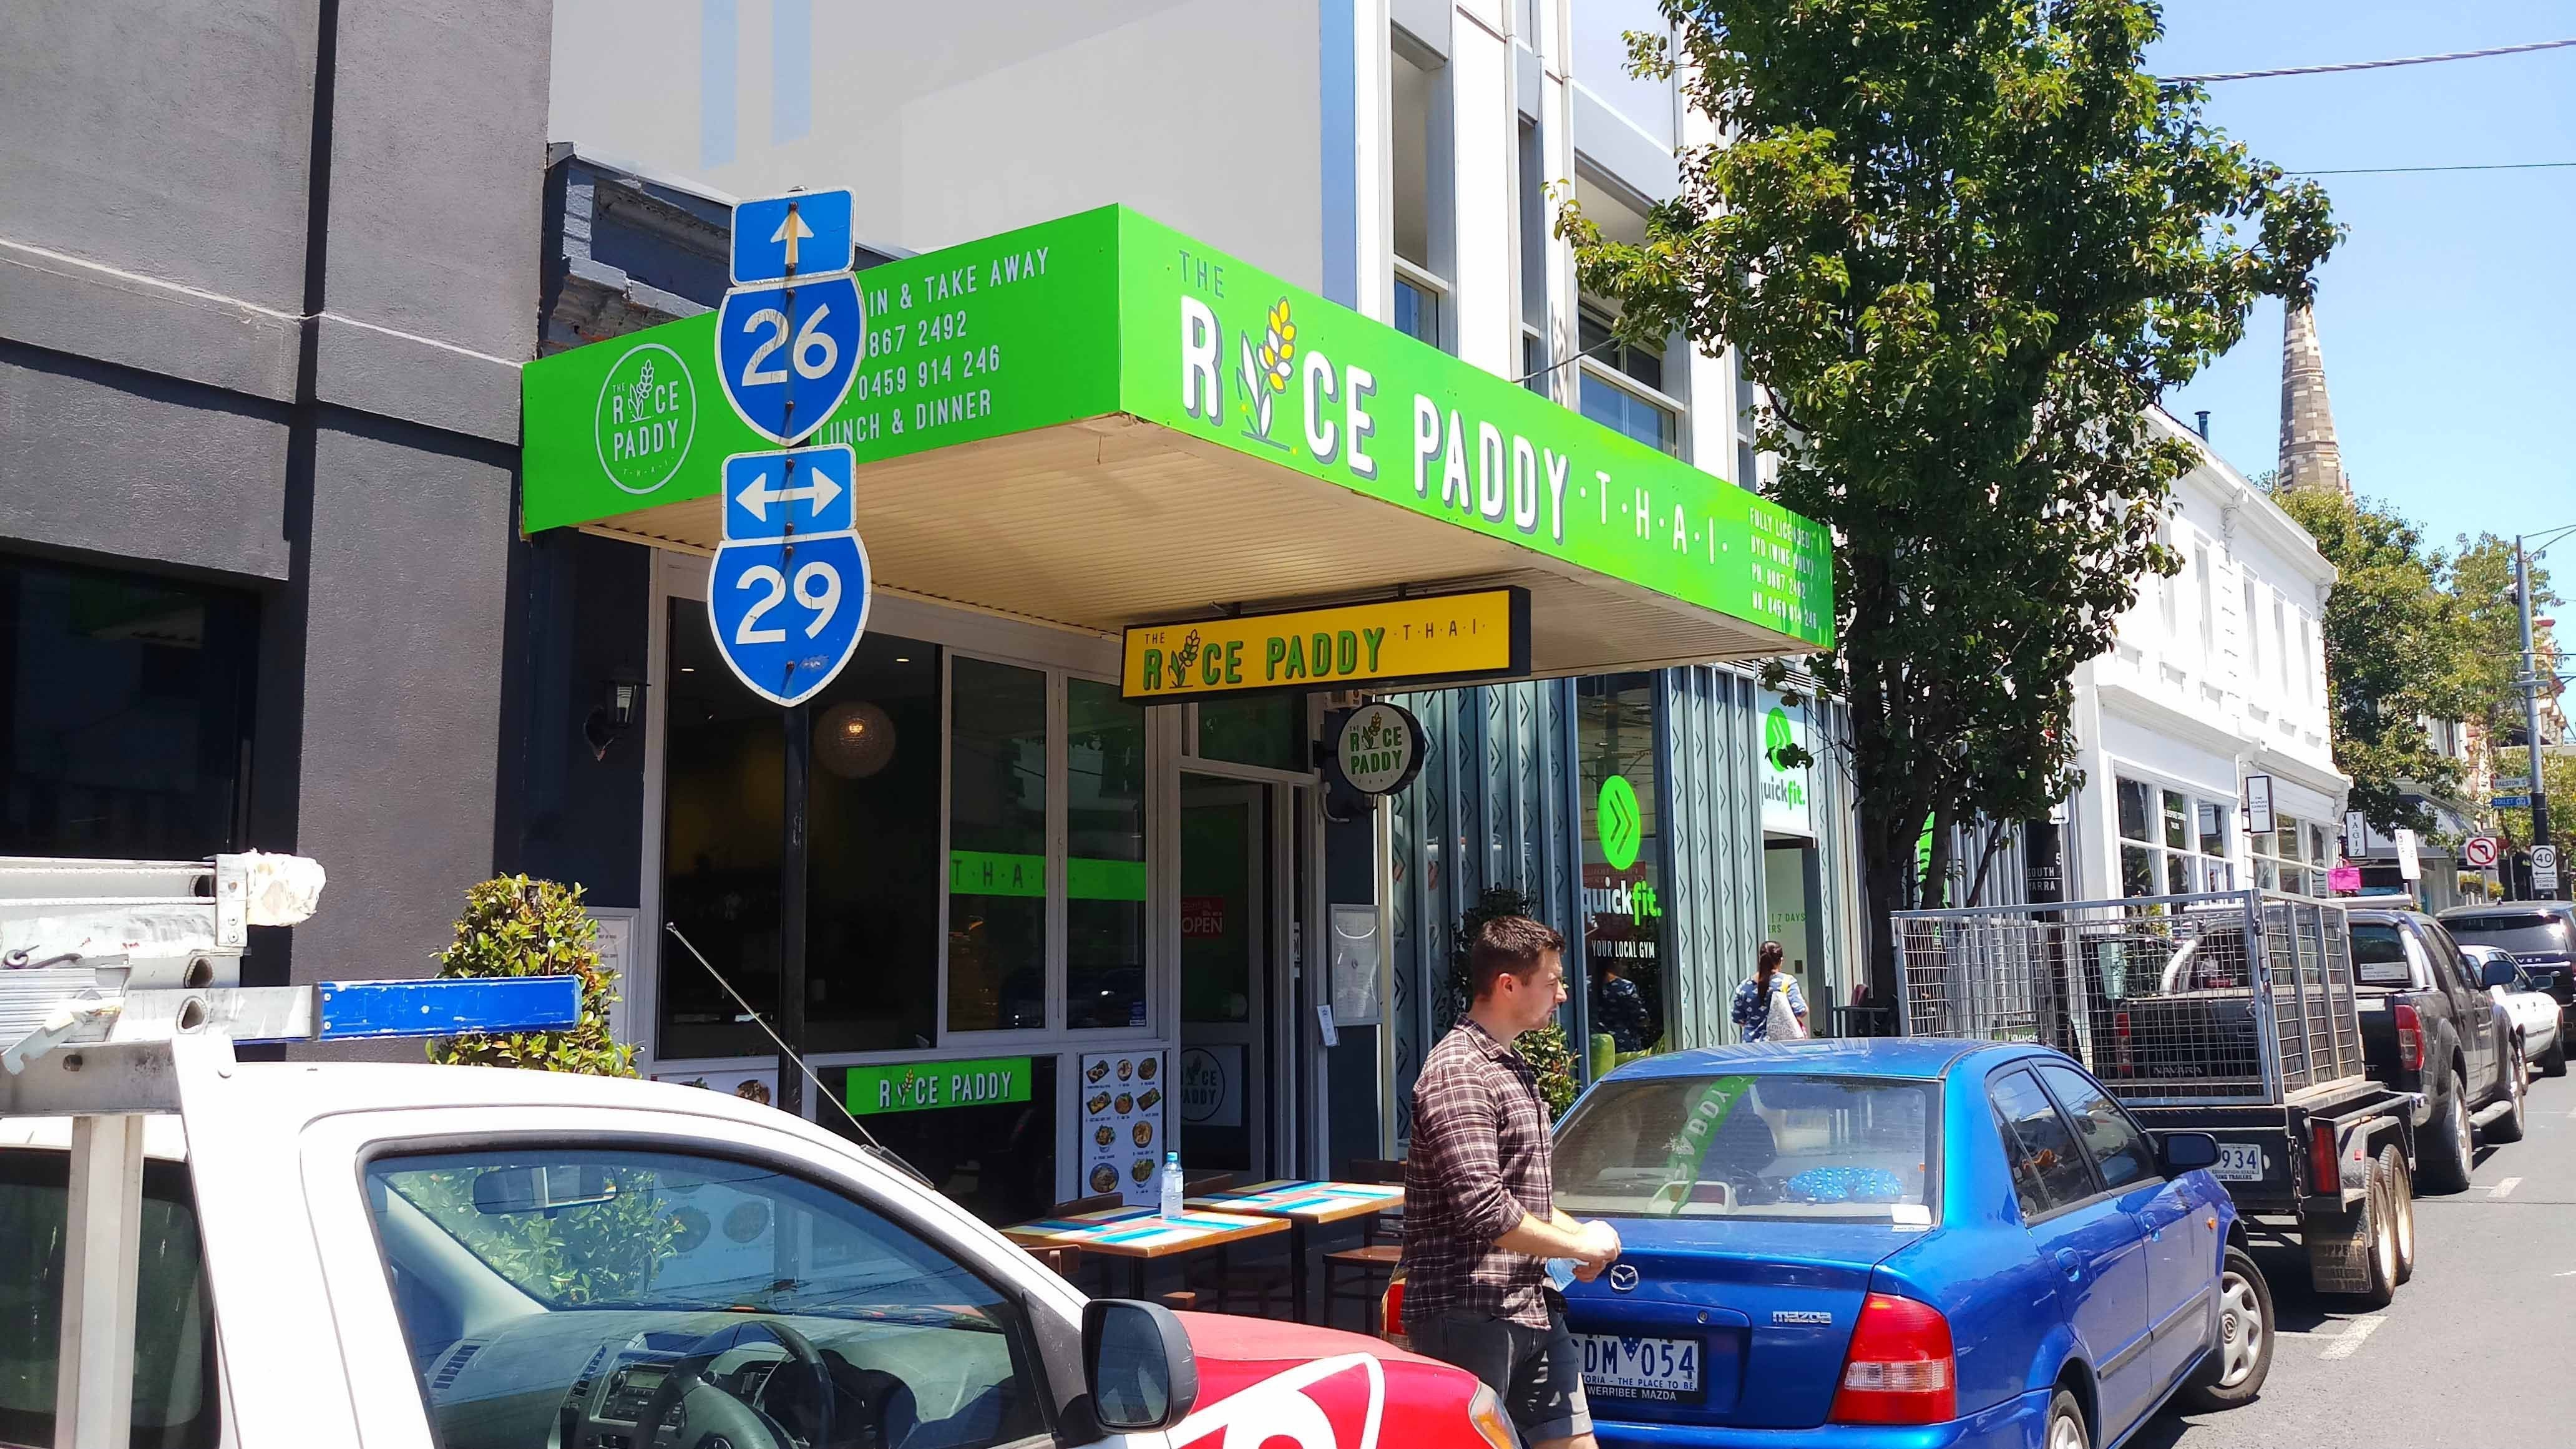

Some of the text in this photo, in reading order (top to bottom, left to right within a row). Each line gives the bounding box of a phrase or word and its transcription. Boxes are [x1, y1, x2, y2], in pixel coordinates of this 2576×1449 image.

[870, 246, 1048, 316] IN & TAKE AWAY
[1179, 249, 1224, 299] THE
[741, 303, 837, 387] 26
[869, 311, 967, 358] 867 2492
[612, 383, 626, 393] THE
[859, 344, 1000, 401] 0459 914 246
[892, 408, 904, 434] &
[916, 389, 991, 430] DINNER
[613, 419, 679, 462] PADDY
[1413, 393, 1571, 545] PADDY
[1749, 507, 1810, 549] FULLY LICENSED
[1750, 534, 1766, 557] BYO
[1769, 542, 1790, 567] (WINE
[736, 561, 842, 645] 29
[1144, 631, 1166, 645] THE
[1266, 627, 1385, 681] PADDY
[1350, 749, 1402, 775] PADDY
[2535, 853, 2552, 862] 40
[1182, 917, 1222, 934] OPEN
[1778, 914, 1782, 922] 7
[1785, 913, 1807, 922] DAYS
[1592, 940, 1655, 959] YOUR LOCAL GYM
[952, 1071, 1012, 1102] PADDY
[1181, 1088, 1217, 1104] ADDY
[1641, 1344, 1694, 1379] 054
[1587, 1385, 1677, 1401] WERRIBEE MAZDA
[1618, 1377, 1633, 1386] THE
[1638, 1379, 1663, 1388] PLACE
[1667, 1380, 1678, 1389] TO
